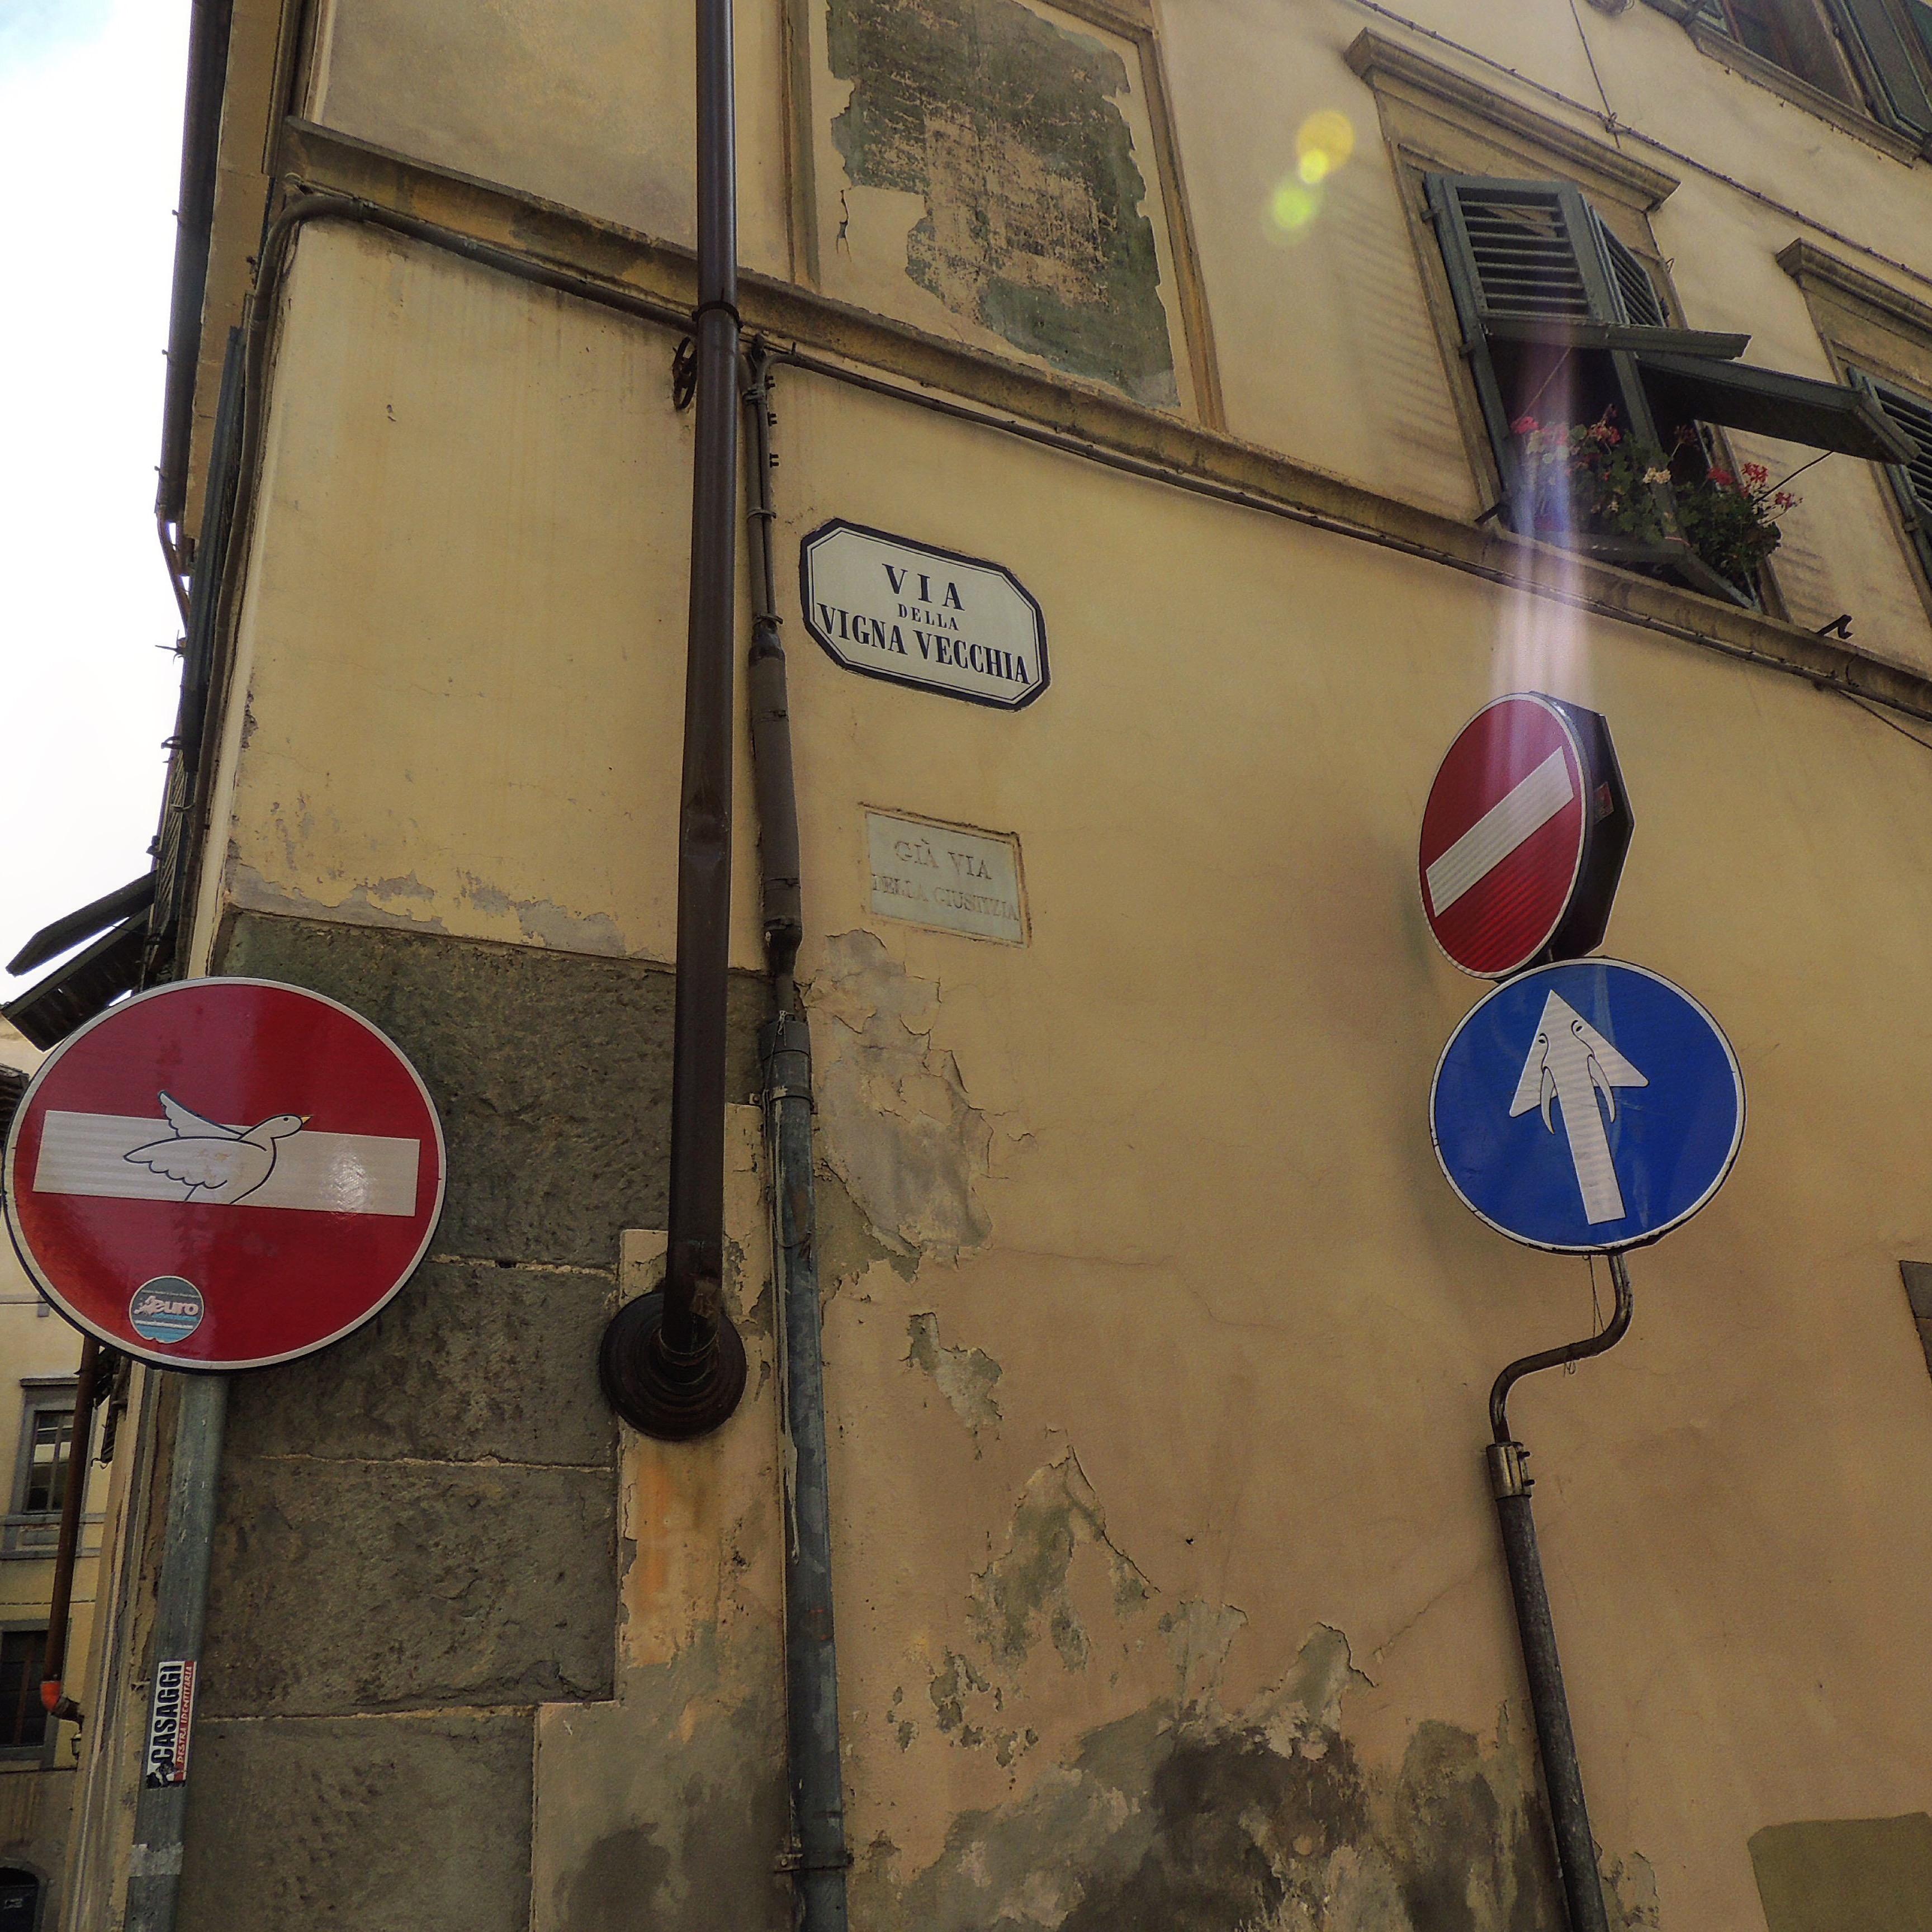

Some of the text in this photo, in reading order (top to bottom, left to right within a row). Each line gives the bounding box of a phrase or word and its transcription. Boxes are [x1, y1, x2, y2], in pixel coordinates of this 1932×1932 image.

[882, 564, 965, 611] VIA
[898, 603, 959, 631] DELLA
[817, 603, 1030, 685] VIGNA VECCHIA
[948, 851, 992, 880] VIA
[177, 1666, 193, 1764] DESTRA IDENTITARIA
